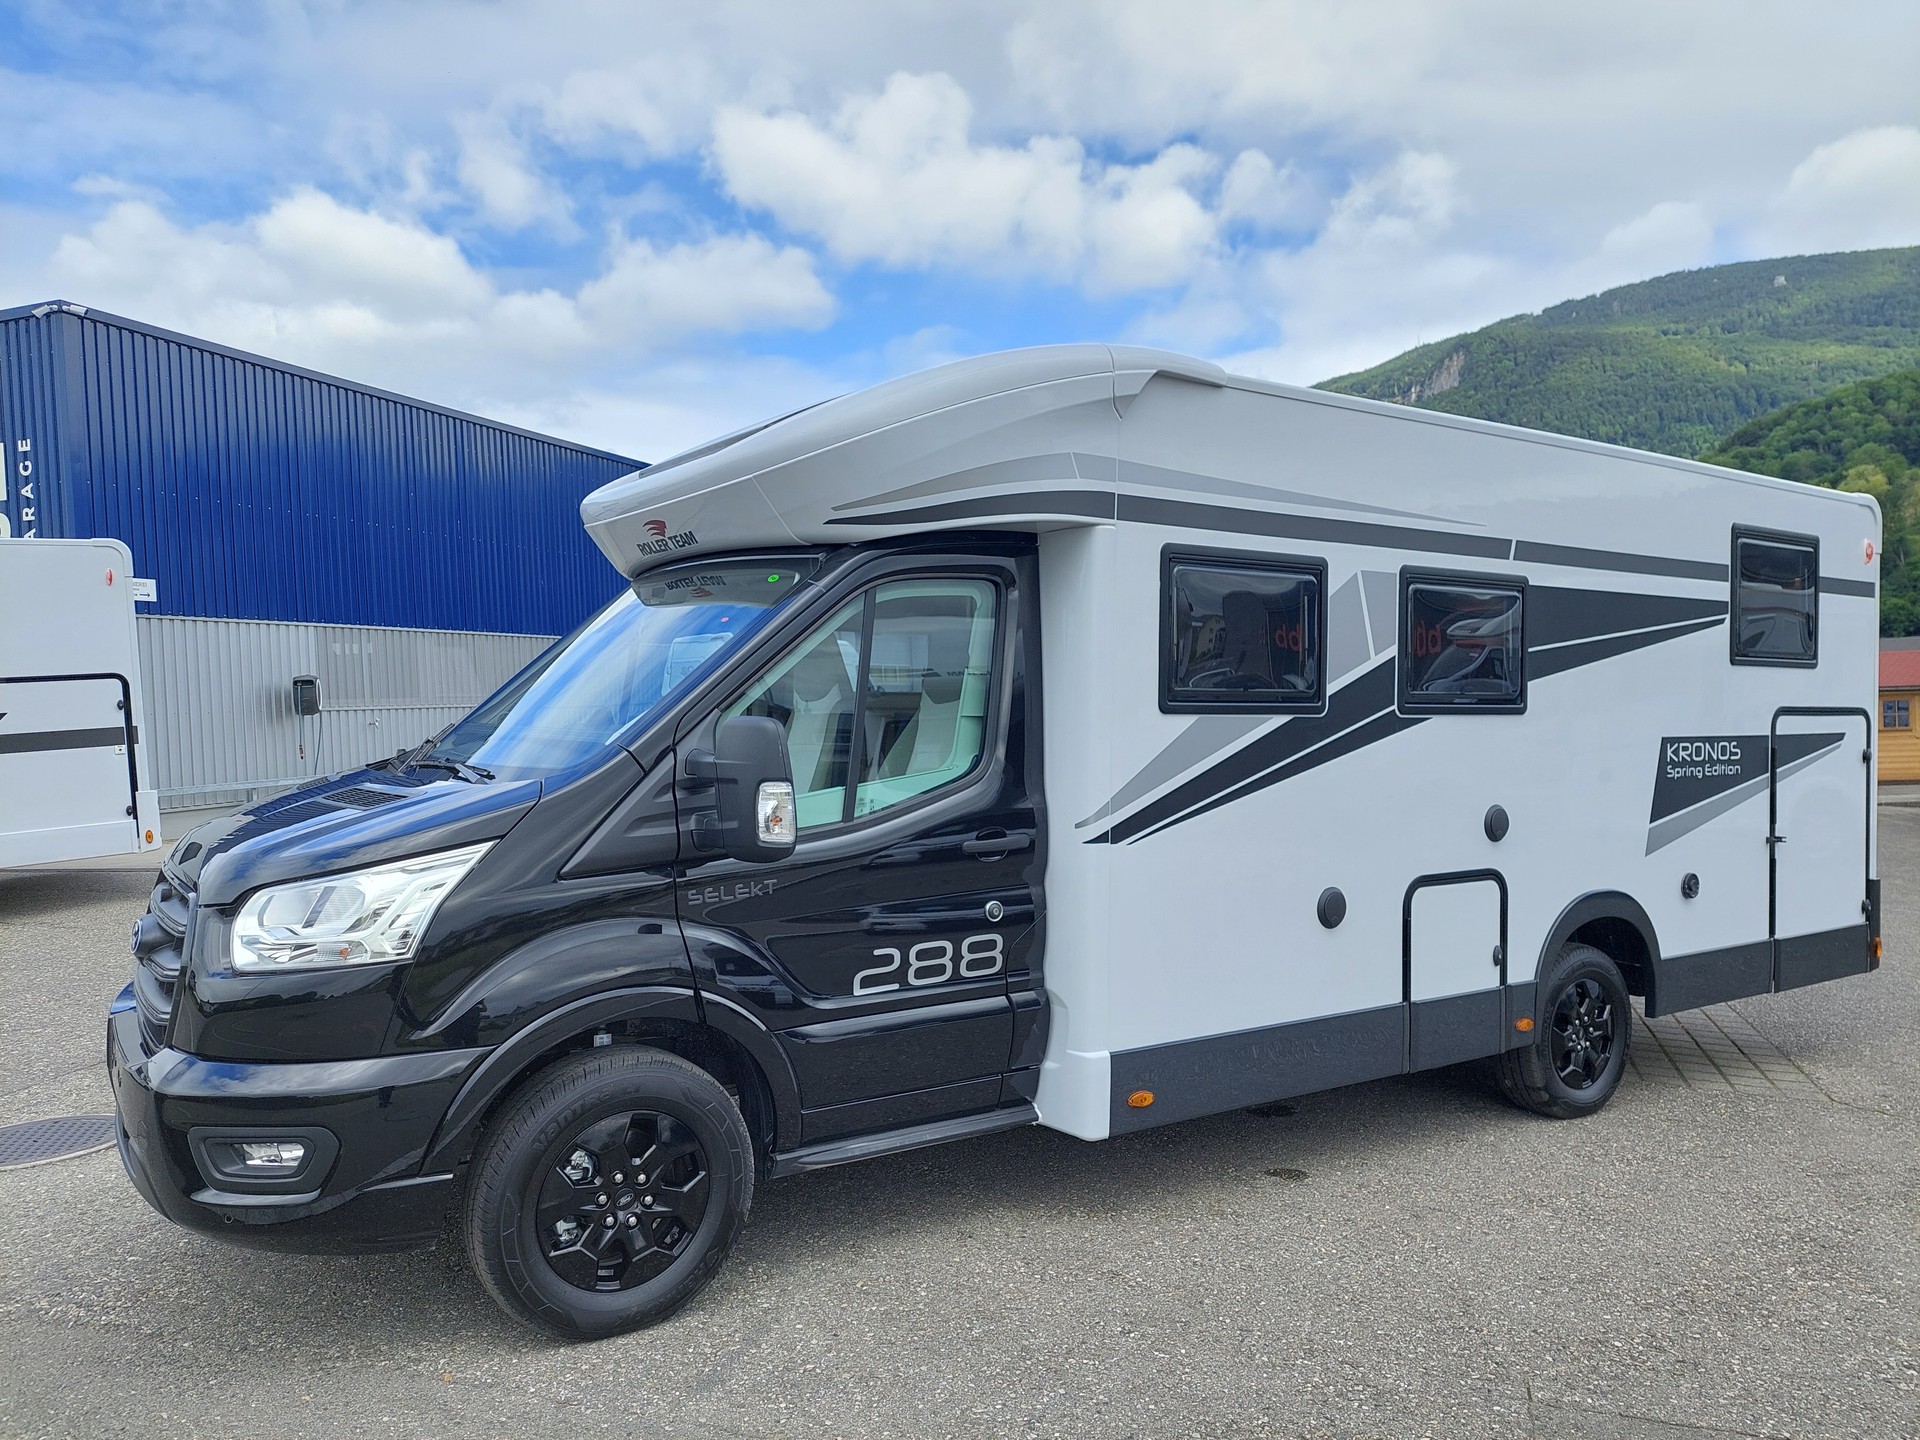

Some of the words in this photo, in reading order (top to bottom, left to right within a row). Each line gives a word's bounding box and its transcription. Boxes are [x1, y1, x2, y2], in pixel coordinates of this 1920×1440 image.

[636, 538, 672, 557] ROLLER
[667, 530, 699, 549] TEAM
[1666, 741, 1741, 762] KRONOS
[1666, 764, 1703, 780] Spring
[1704, 763, 1741, 776] Edition
[687, 879, 778, 906] SELEKT
[853, 933, 1004, 996] 288
